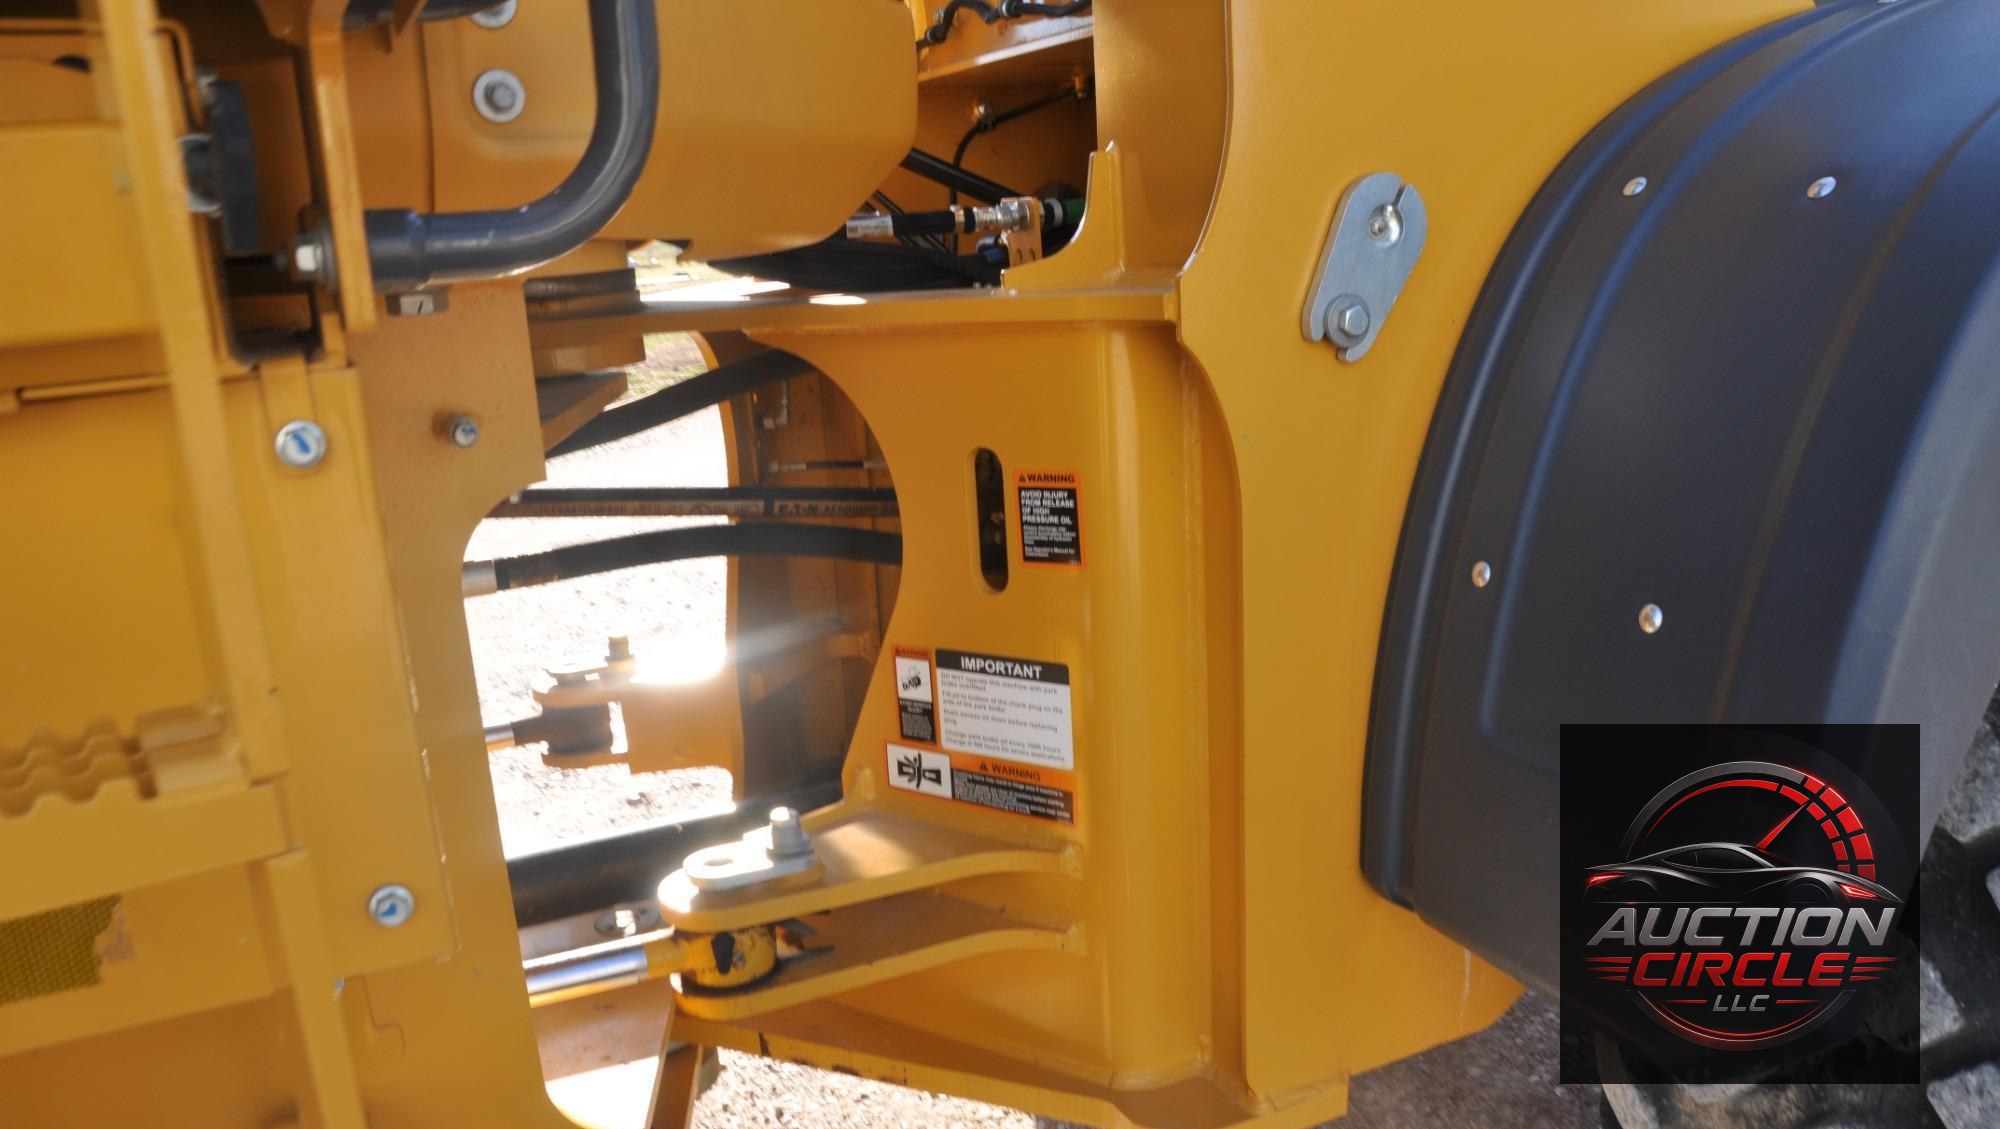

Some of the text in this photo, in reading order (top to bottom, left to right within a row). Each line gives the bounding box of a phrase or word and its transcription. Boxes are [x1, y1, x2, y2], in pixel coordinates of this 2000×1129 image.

[1028, 473, 1075, 483] WARNING
[1021, 490, 1068, 499] AVOID INJURY
[1043, 499, 1075, 508] RELEASE
[1023, 515, 1072, 525] PRESSURE OIL
[960, 656, 1042, 679] IMPORTANT
[992, 762, 1041, 780] WARNING
